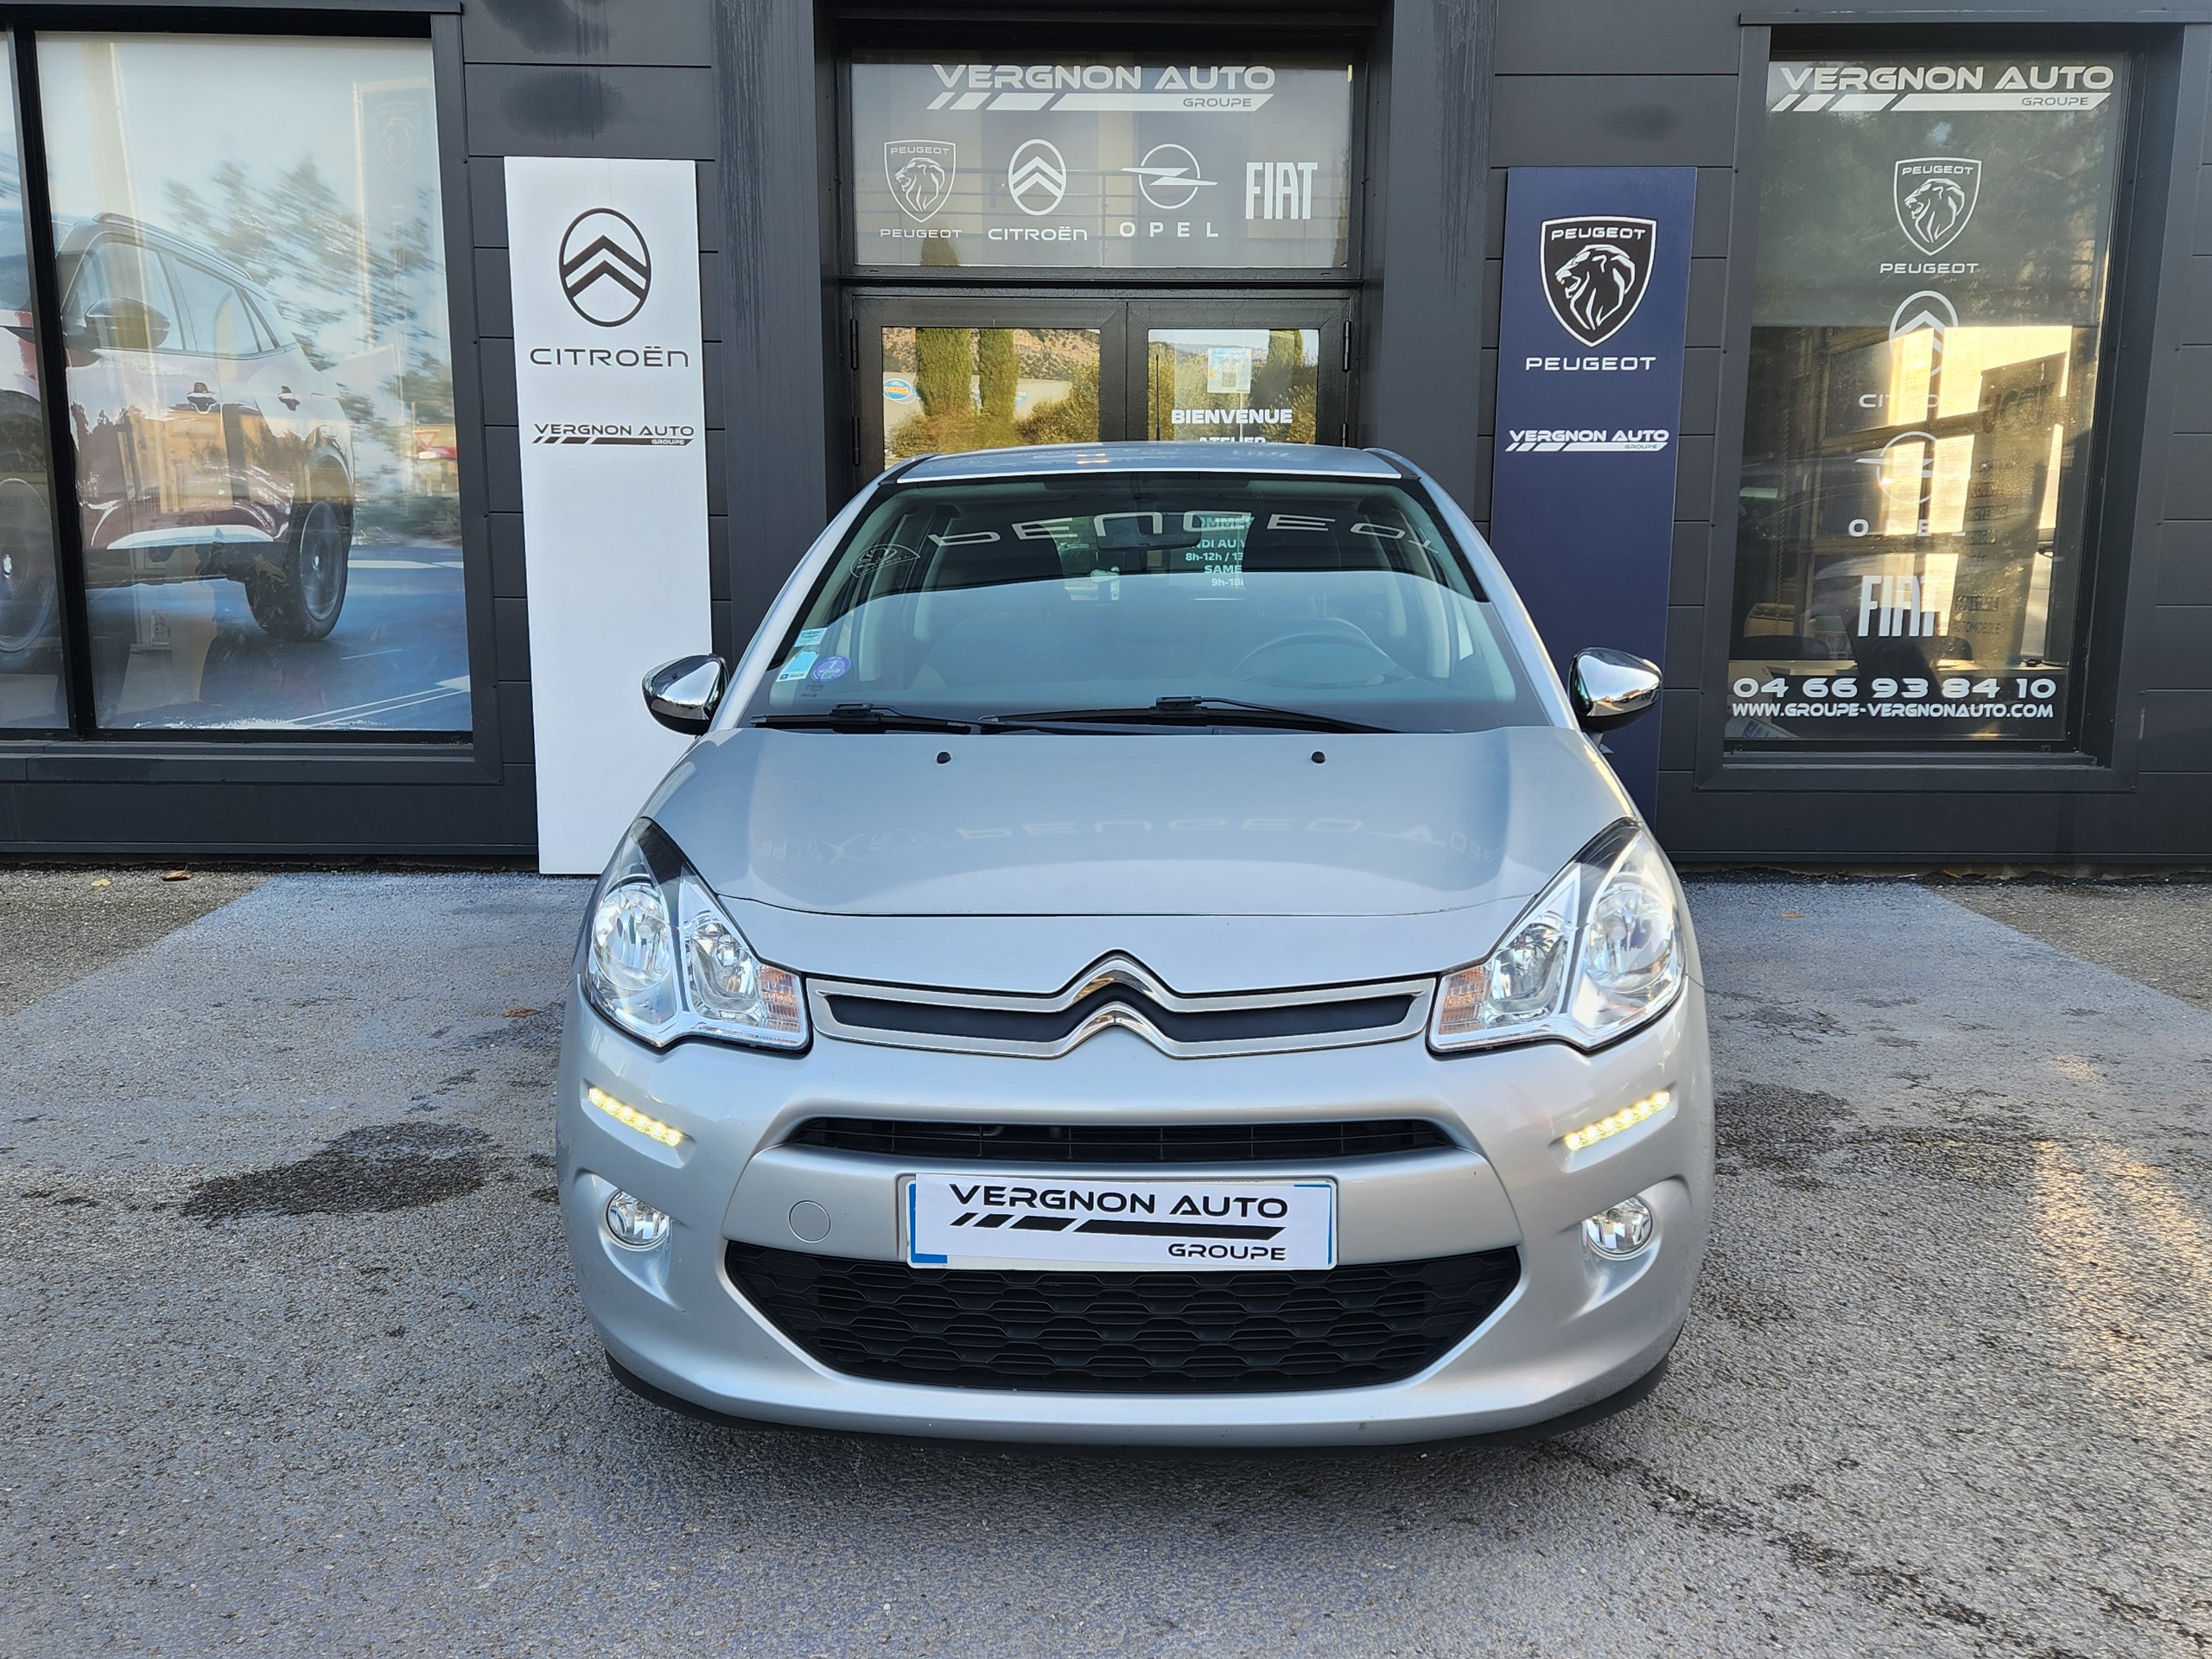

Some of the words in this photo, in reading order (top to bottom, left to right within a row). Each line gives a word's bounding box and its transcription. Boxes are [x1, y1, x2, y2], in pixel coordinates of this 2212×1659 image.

[932, 65, 1141, 90] VERGNON
[1154, 66, 1275, 90] AUTO
[1780, 67, 1983, 91] VERGNON
[1994, 67, 2113, 90] AUTO
[1183, 98, 1252, 108] GROUPE
[2021, 96, 2089, 107] GROUPE
[890, 145, 950, 156] PEUGEOT
[1902, 165, 1974, 175] PEUGEOT
[1245, 162, 1318, 219] FIAT
[880, 229, 963, 238] PEUGEOT
[1119, 221, 1219, 238] OPEL
[1550, 226, 1646, 241] PEUGEOT
[1880, 263, 1979, 274] PEUGEOT
[1525, 356, 1657, 372] PEUGEOT
[1171, 409, 1294, 424] BIENVENUE
[534, 423, 632, 435] VERGNON
[639, 424, 695, 436] AUTO
[1509, 429, 1607, 442] VERGNON
[1611, 429, 1669, 442] AUTO
[1217, 539, 1237, 549] AU
[1204, 564, 1243, 575] SAME
[1732, 677, 1789, 698] 04
[1802, 677, 1859, 698] 66
[1872, 677, 1929, 698] 93
[1942, 677, 2000, 698] 84
[2017, 677, 2056, 698] 10
[1732, 702, 2054, 718] WWW.GROUPE-VERGNONAUTO.COM
[949, 1183, 1155, 1214] VERGNON
[1168, 1195, 1288, 1219] AUTO
[1167, 1243, 1287, 1262] GROUPE
